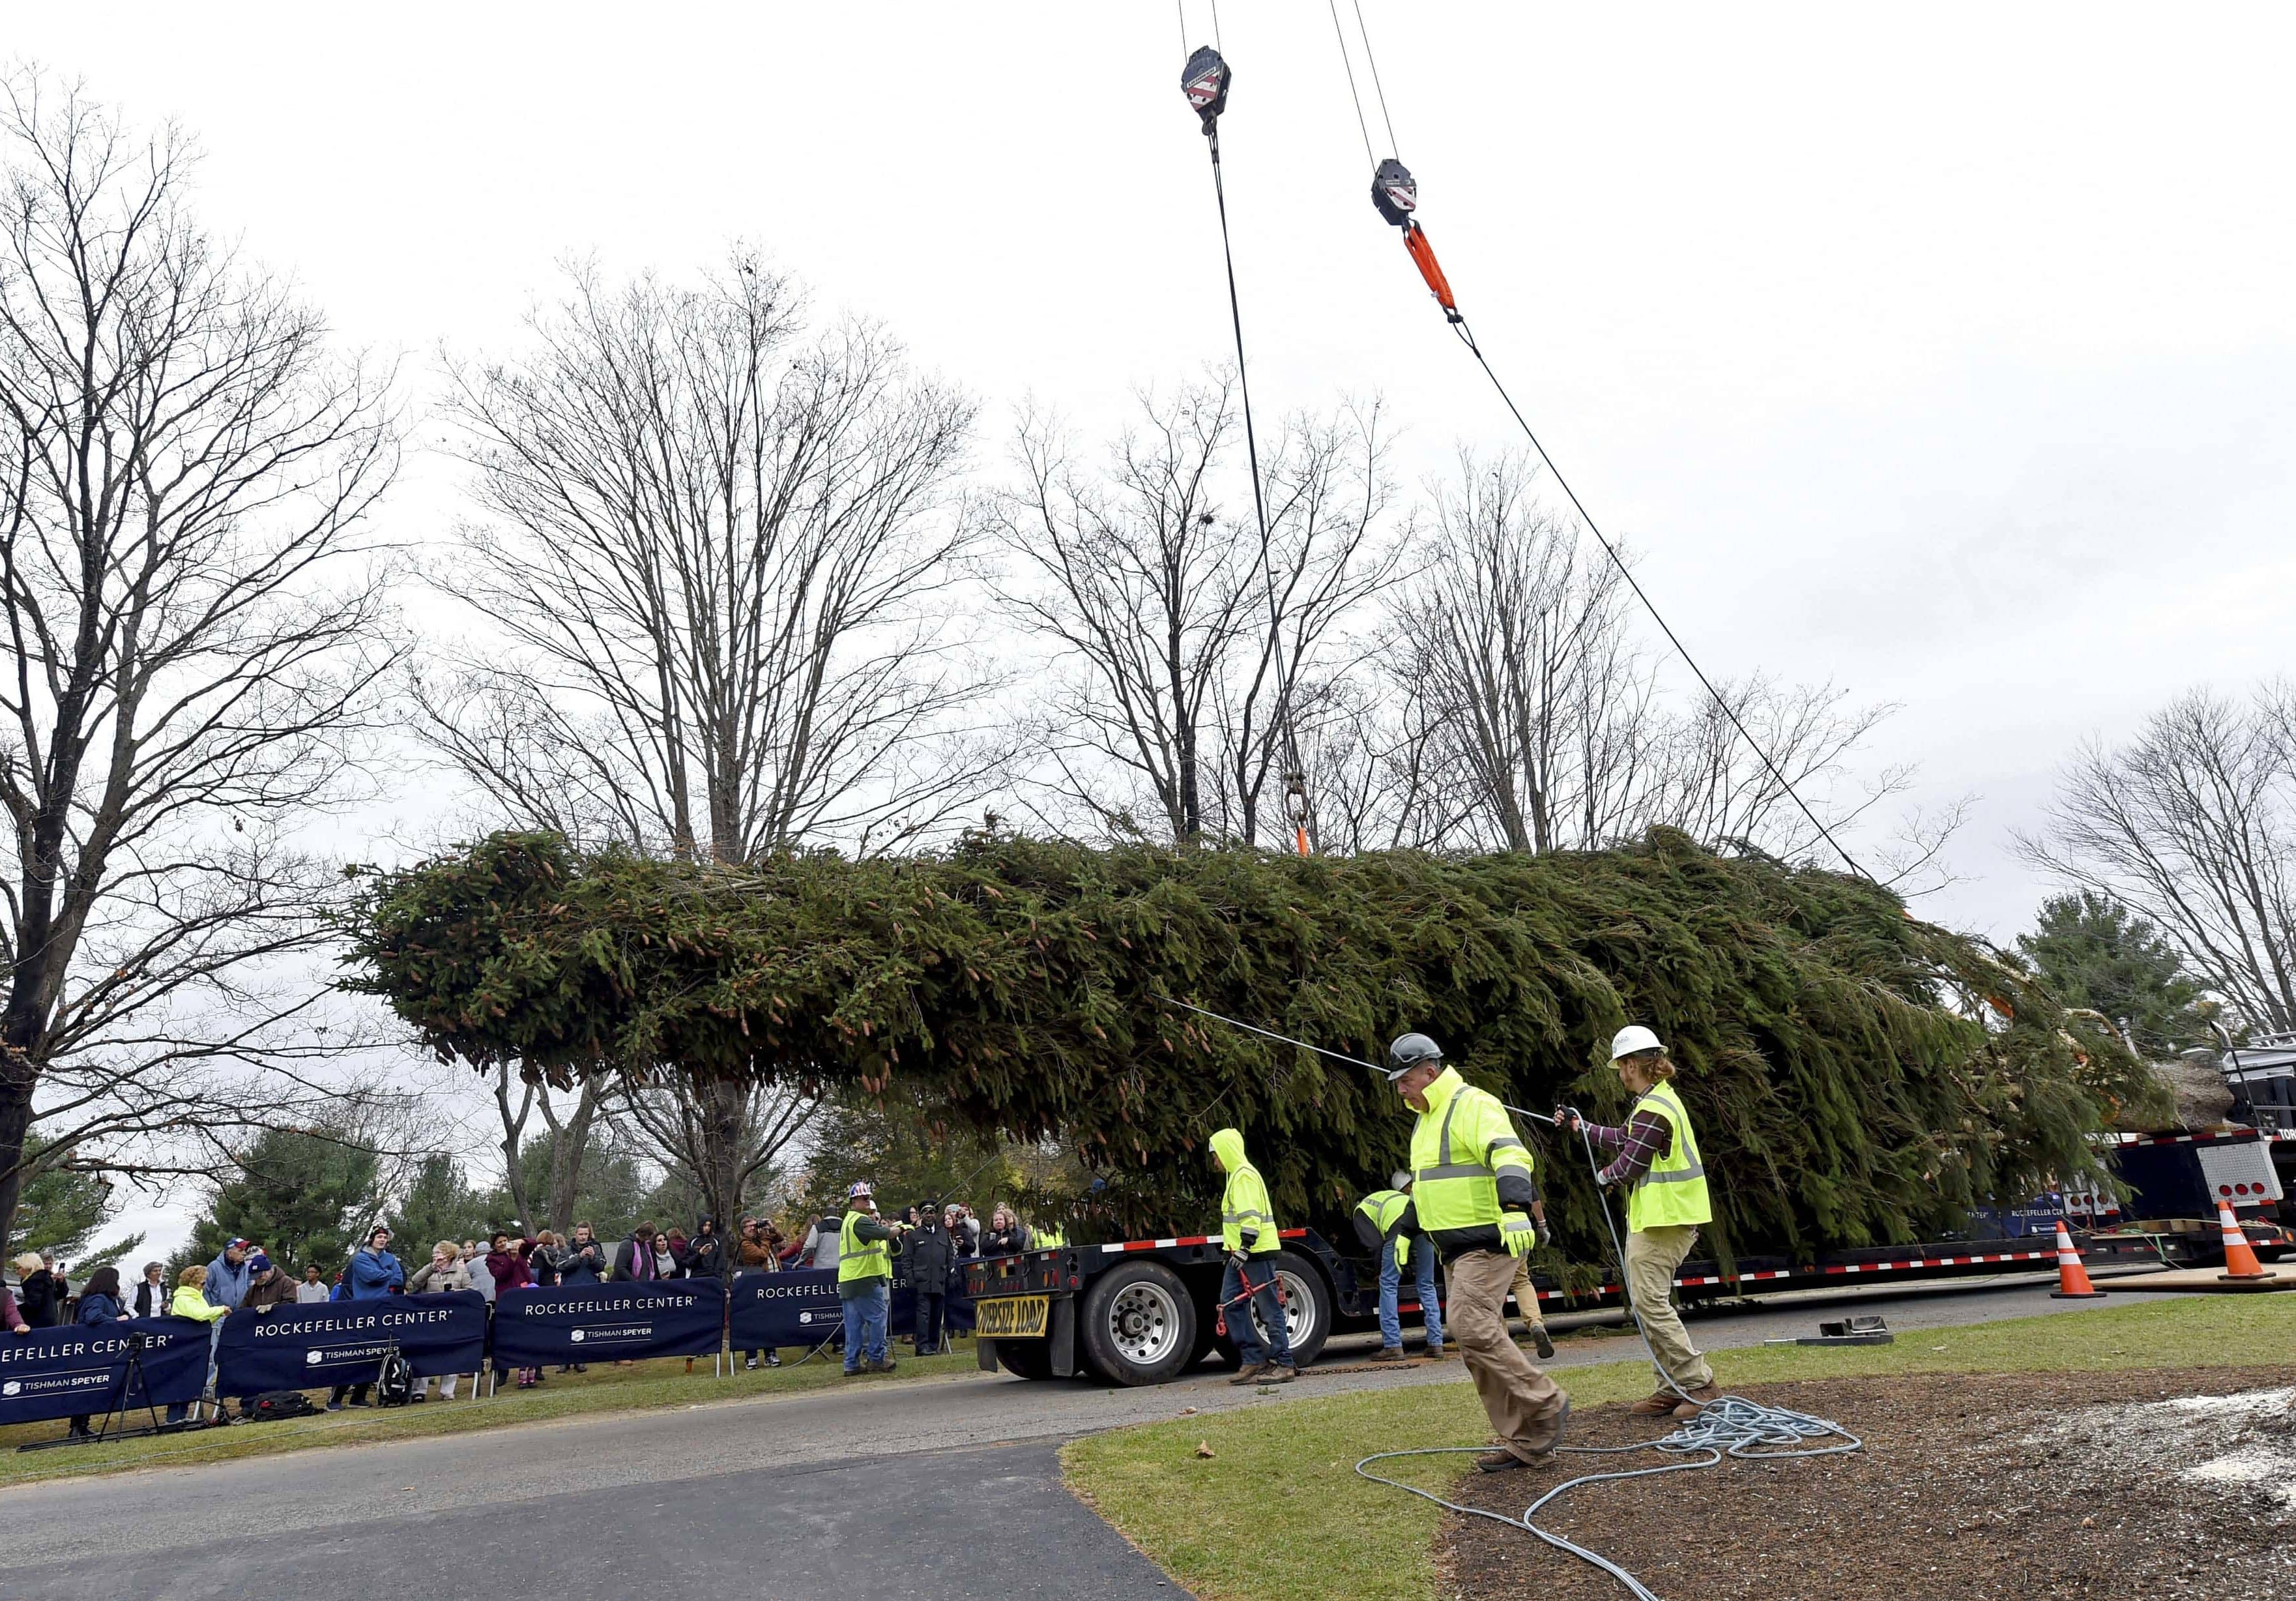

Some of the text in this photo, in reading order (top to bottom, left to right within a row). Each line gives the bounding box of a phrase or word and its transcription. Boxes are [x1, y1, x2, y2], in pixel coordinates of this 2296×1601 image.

[2278, 1128, 2296, 1141] TOR
[2011, 1208, 2052, 1217] ROCEFELLER
[757, 1284, 841, 1299] ROCKEFELLE
[525, 1299, 631, 1315] ROCKEFELLER
[978, 1299, 1045, 1334] OVERSIZE LOAD
[255, 1315, 375, 1337] ROCKEFELLER
[587, 1330, 621, 1338] TISHMAN
[92, 1335, 167, 1353] CENER
[325, 1349, 364, 1359] TISHMAN
[25, 1375, 109, 1390] TISHMAN SPEYER
